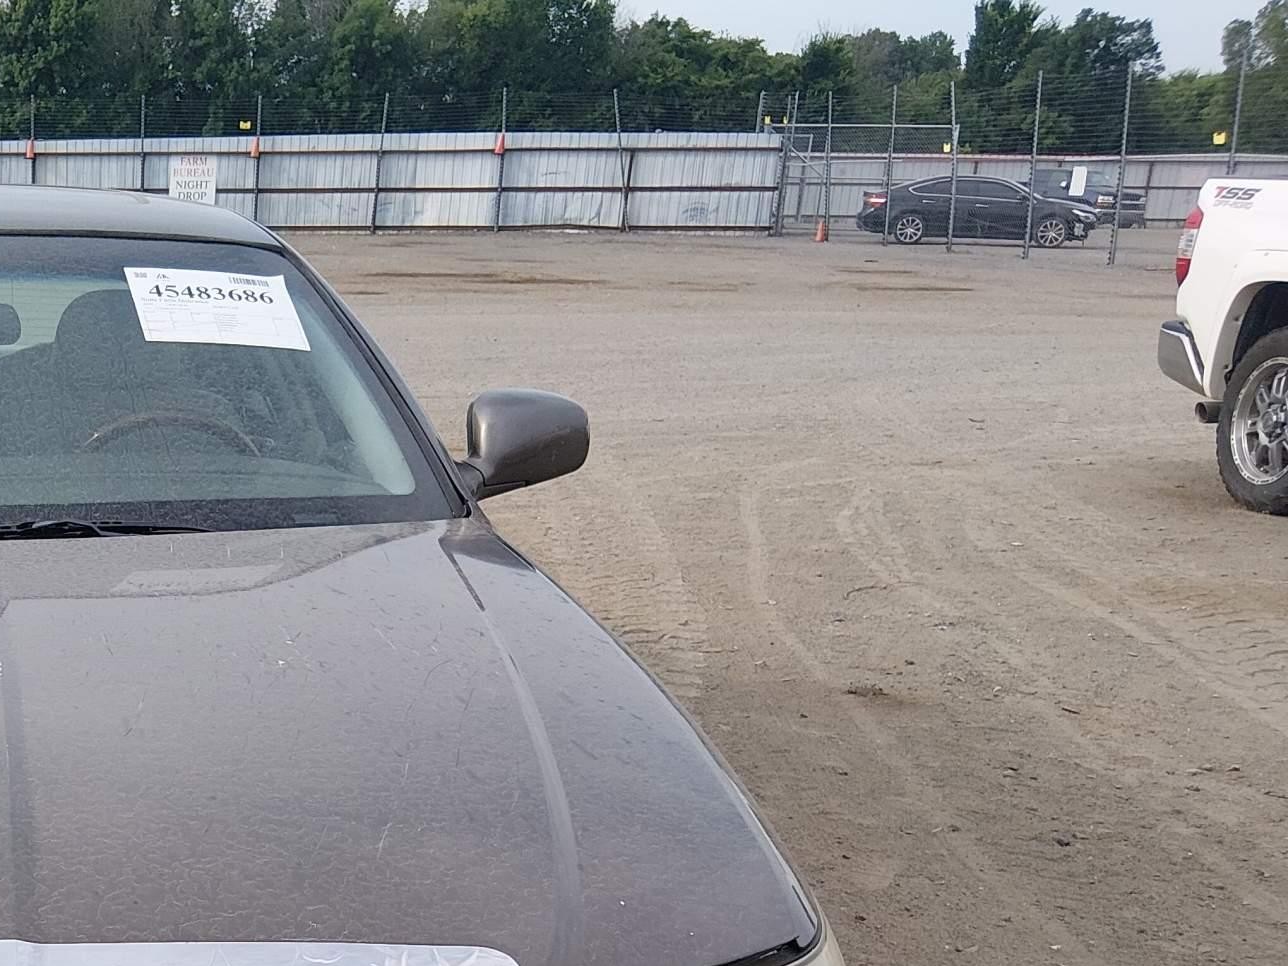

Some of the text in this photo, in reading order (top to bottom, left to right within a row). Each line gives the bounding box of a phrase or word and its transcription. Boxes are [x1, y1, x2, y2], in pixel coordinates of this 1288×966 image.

[180, 156, 208, 167] FARM
[173, 167, 214, 177] BUREAU
[175, 180, 211, 190] NIGHT
[177, 191, 207, 200] DROP
[149, 284, 274, 304] 45483686
